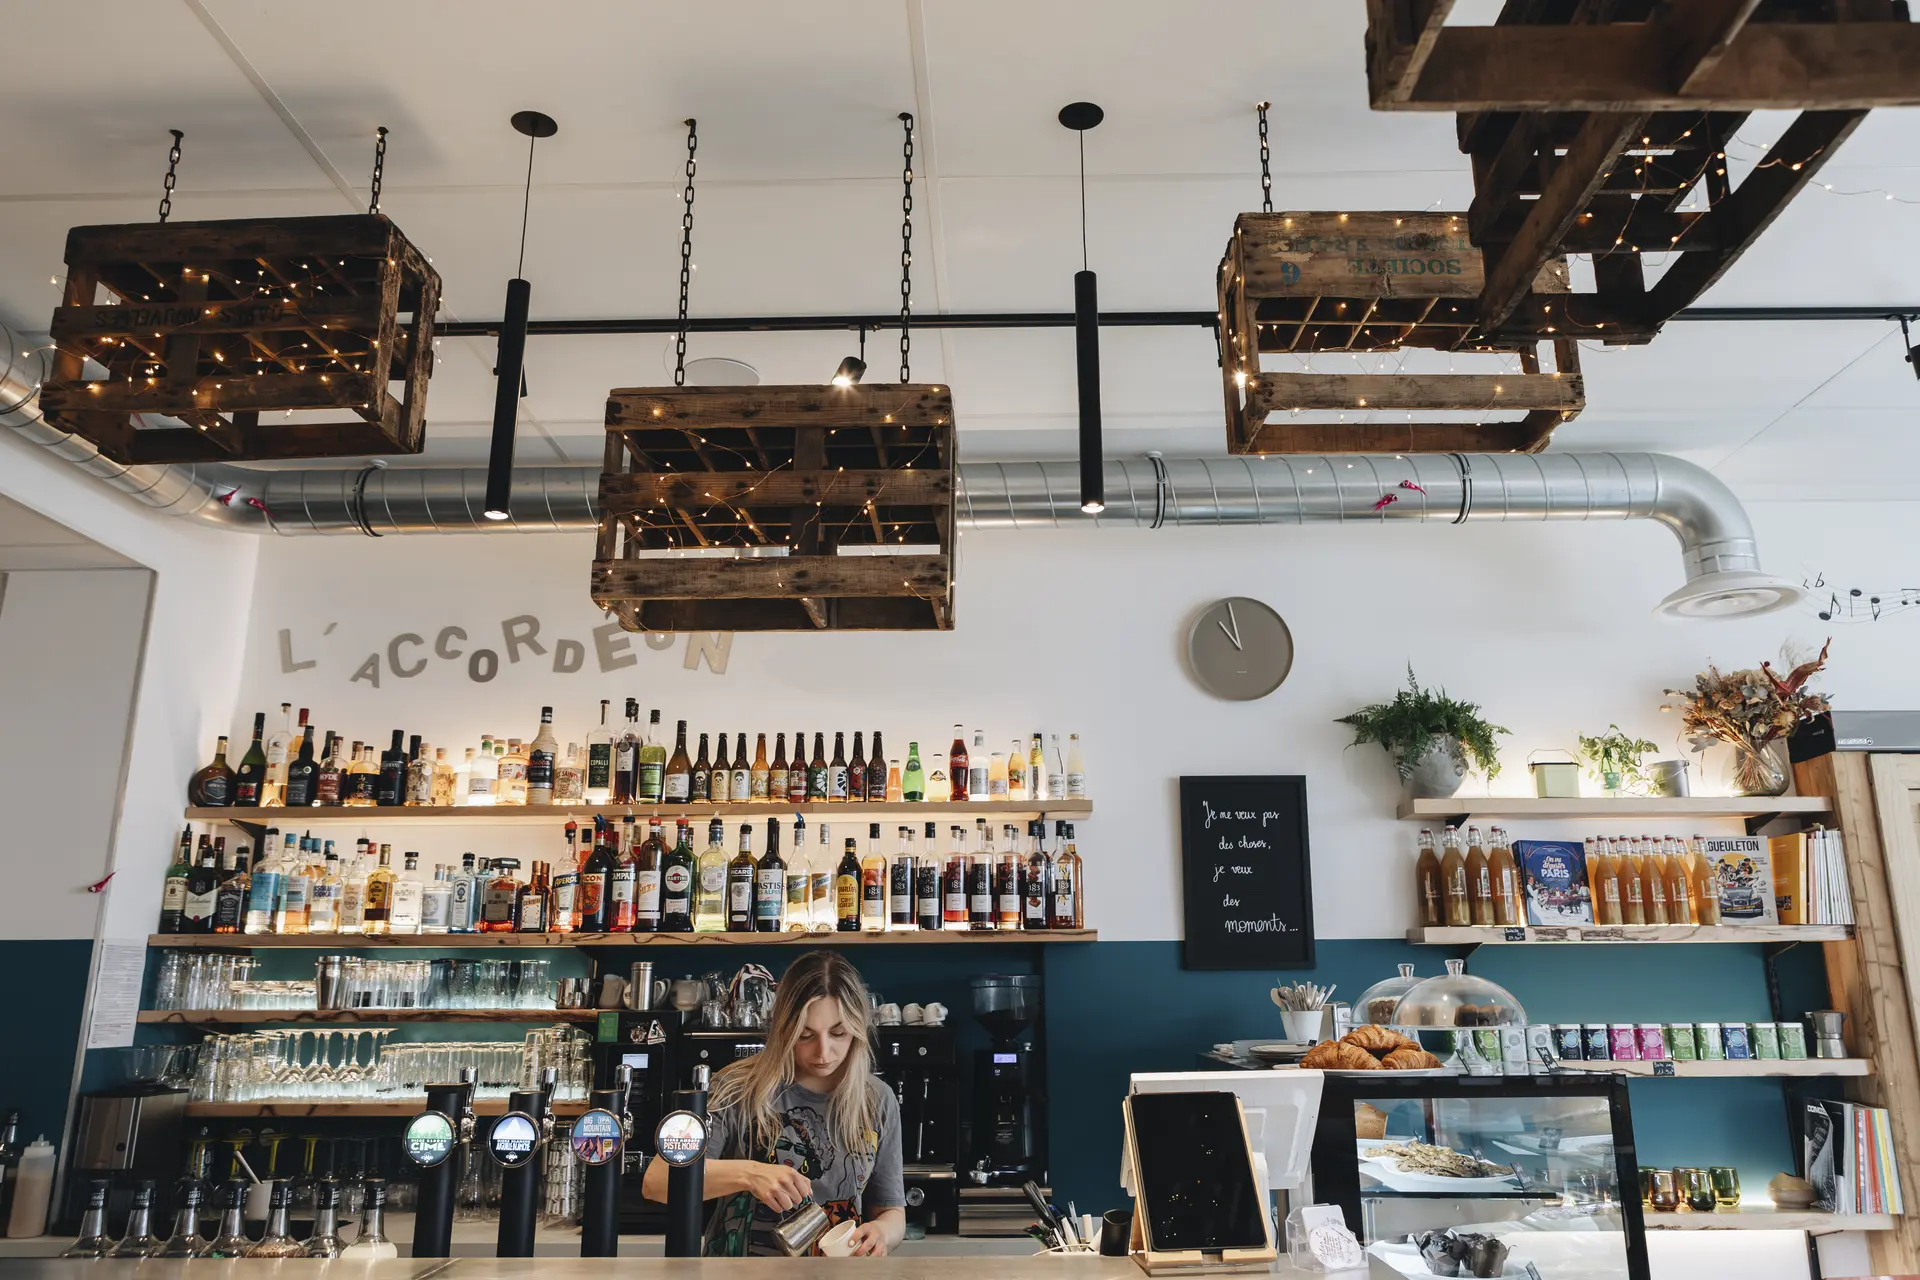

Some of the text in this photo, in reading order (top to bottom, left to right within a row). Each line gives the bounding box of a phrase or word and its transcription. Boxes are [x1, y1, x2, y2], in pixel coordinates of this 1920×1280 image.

[1220, 811, 1232, 820] ne
[1235, 811, 1256, 820] veux
[1263, 811, 1280, 827] pas
[1219, 836, 1234, 850] des
[1708, 840, 1760, 852] GUEULETON
[1213, 864, 1253, 882] je veux
[1541, 869, 1570, 878] PARIS
[554, 875, 578, 887] APEROL
[1223, 894, 1240, 907] des
[584, 1116, 593, 1124] BIG
[583, 1124, 612, 1133] MOUNTAIN
[411, 1142, 446, 1151] CIME
[664, 1142, 700, 1150] PISTE NOIRE
